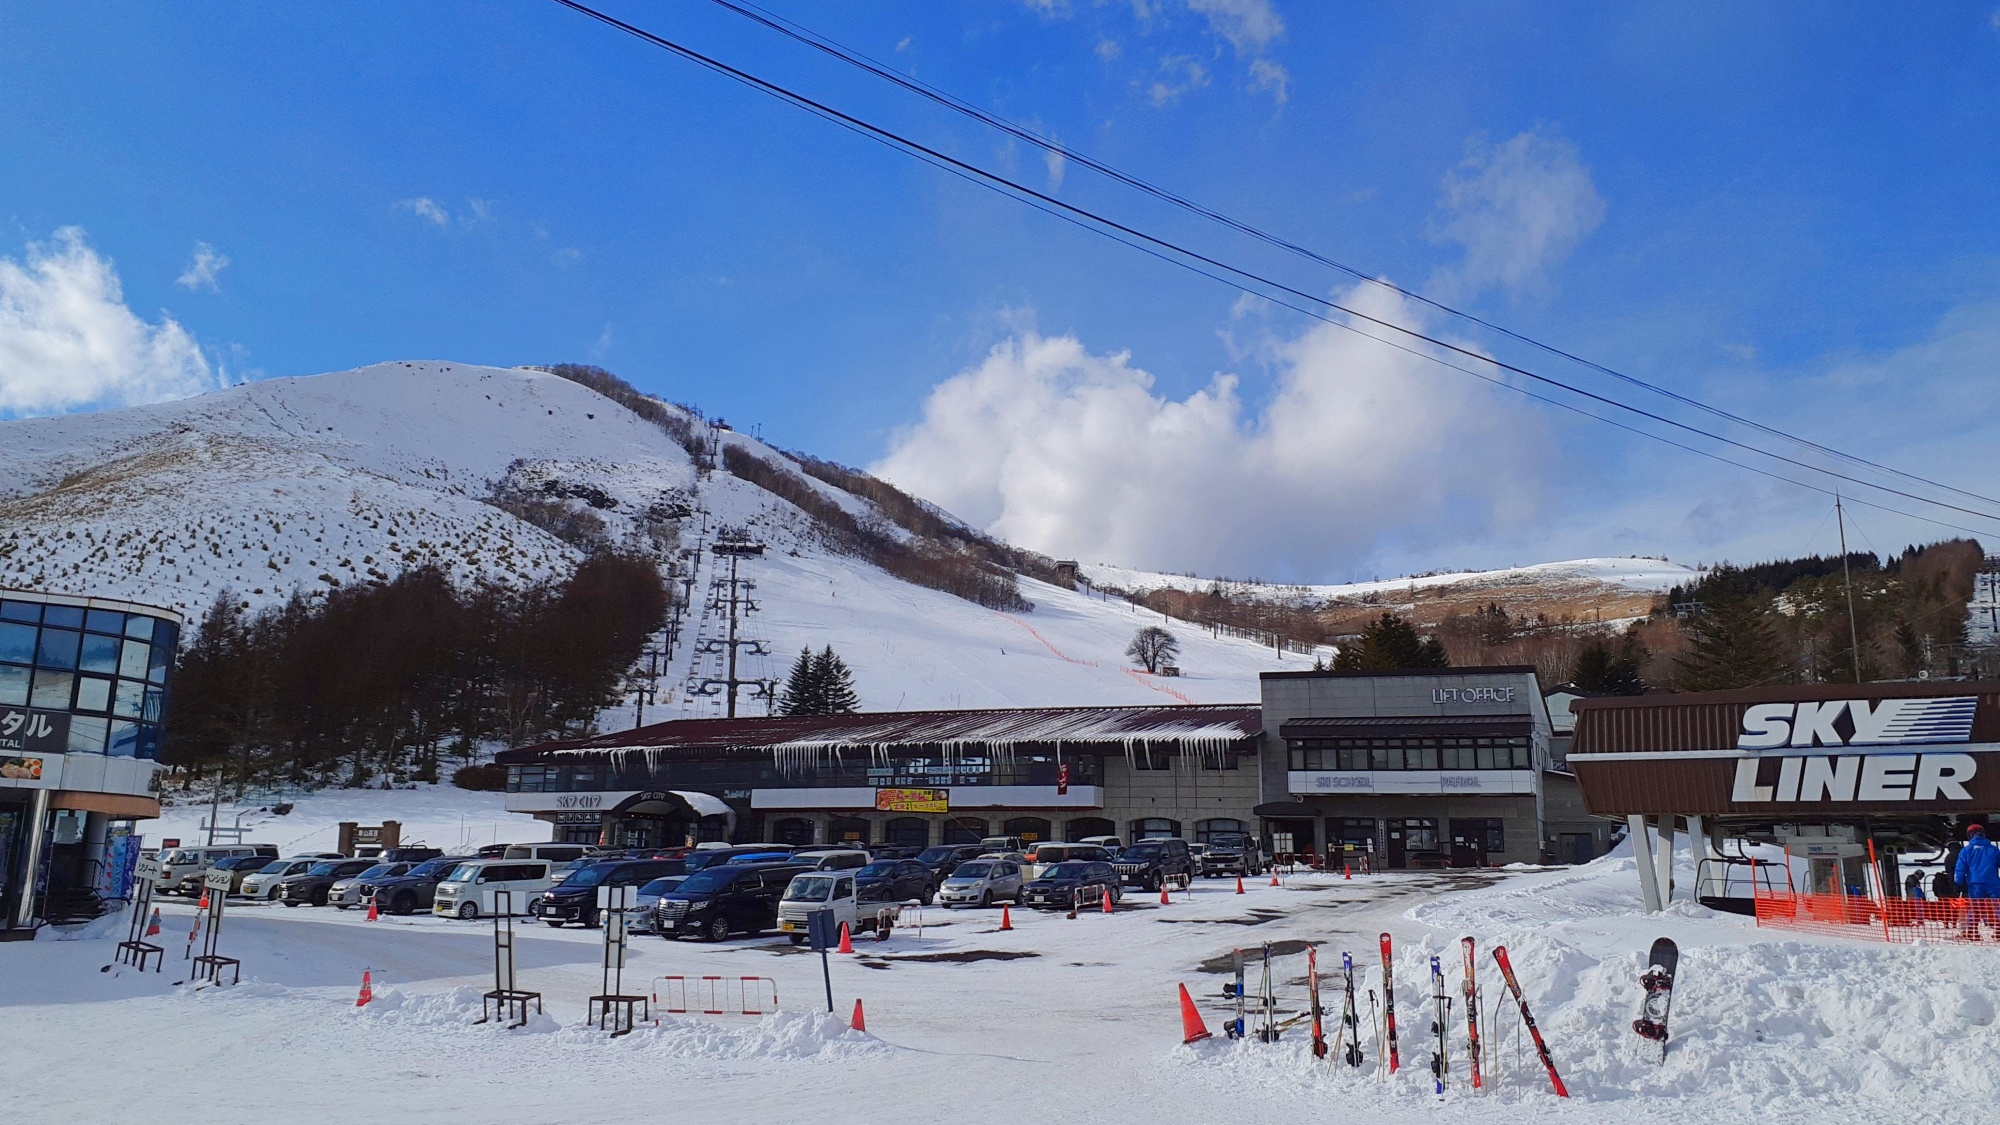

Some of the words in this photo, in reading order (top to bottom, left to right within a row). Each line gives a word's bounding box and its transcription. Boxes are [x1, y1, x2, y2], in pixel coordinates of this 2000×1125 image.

[1432, 688, 1459, 703] LIFT
[1461, 687, 1515, 703] OFFICE
[0, 710, 53, 738] タル
[1737, 696, 1978, 749] SKY
[0, 739, 21, 748] TAL
[1316, 776, 1331, 788] SKI
[1333, 776, 1373, 788] SCHOOL
[1441, 776, 1482, 788] PATROL
[1731, 753, 1977, 802] LINER
[556, 795, 577, 808] SKY
[577, 795, 602, 808] CITY
[640, 792, 651, 800] SKY
[652, 792, 666, 800] CITY
